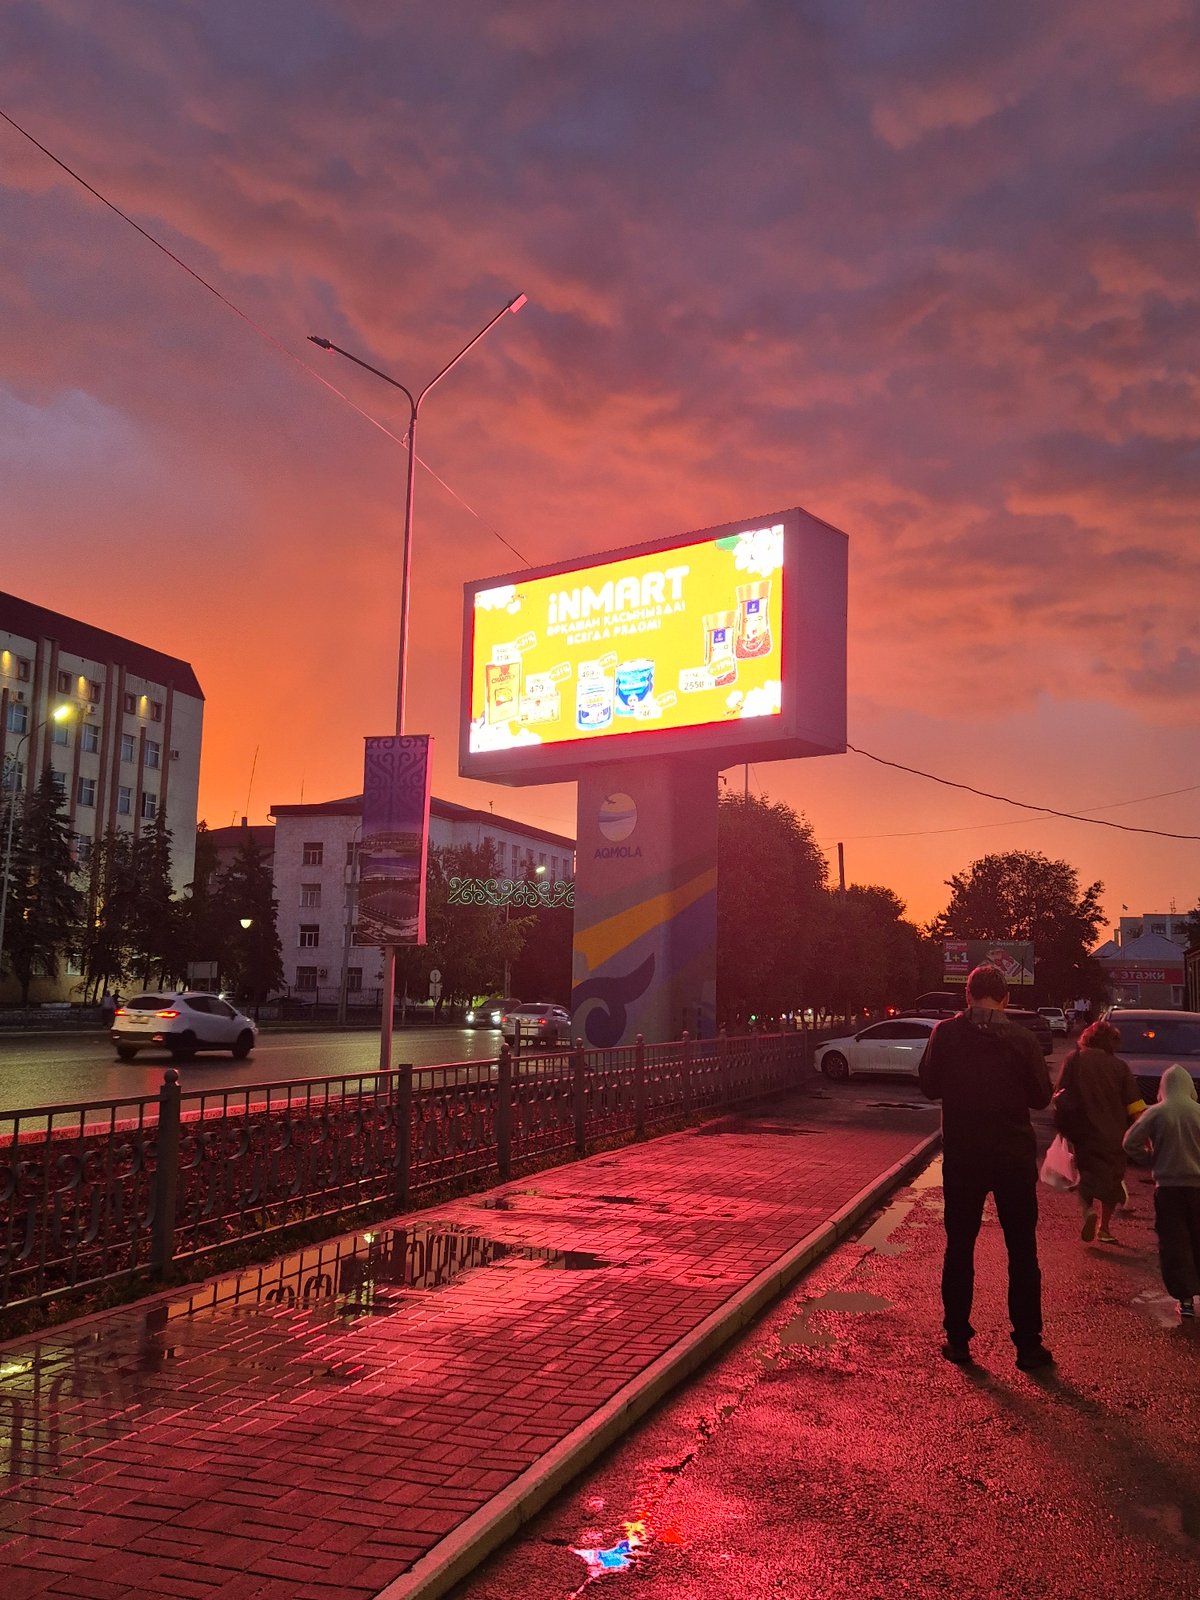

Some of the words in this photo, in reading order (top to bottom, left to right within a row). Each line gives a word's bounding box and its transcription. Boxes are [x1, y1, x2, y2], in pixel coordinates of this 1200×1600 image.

[593, 846, 642, 859] AQMOLA
[943, 951, 969, 963] 1+1
[1121, 971, 1165, 980] этажи
